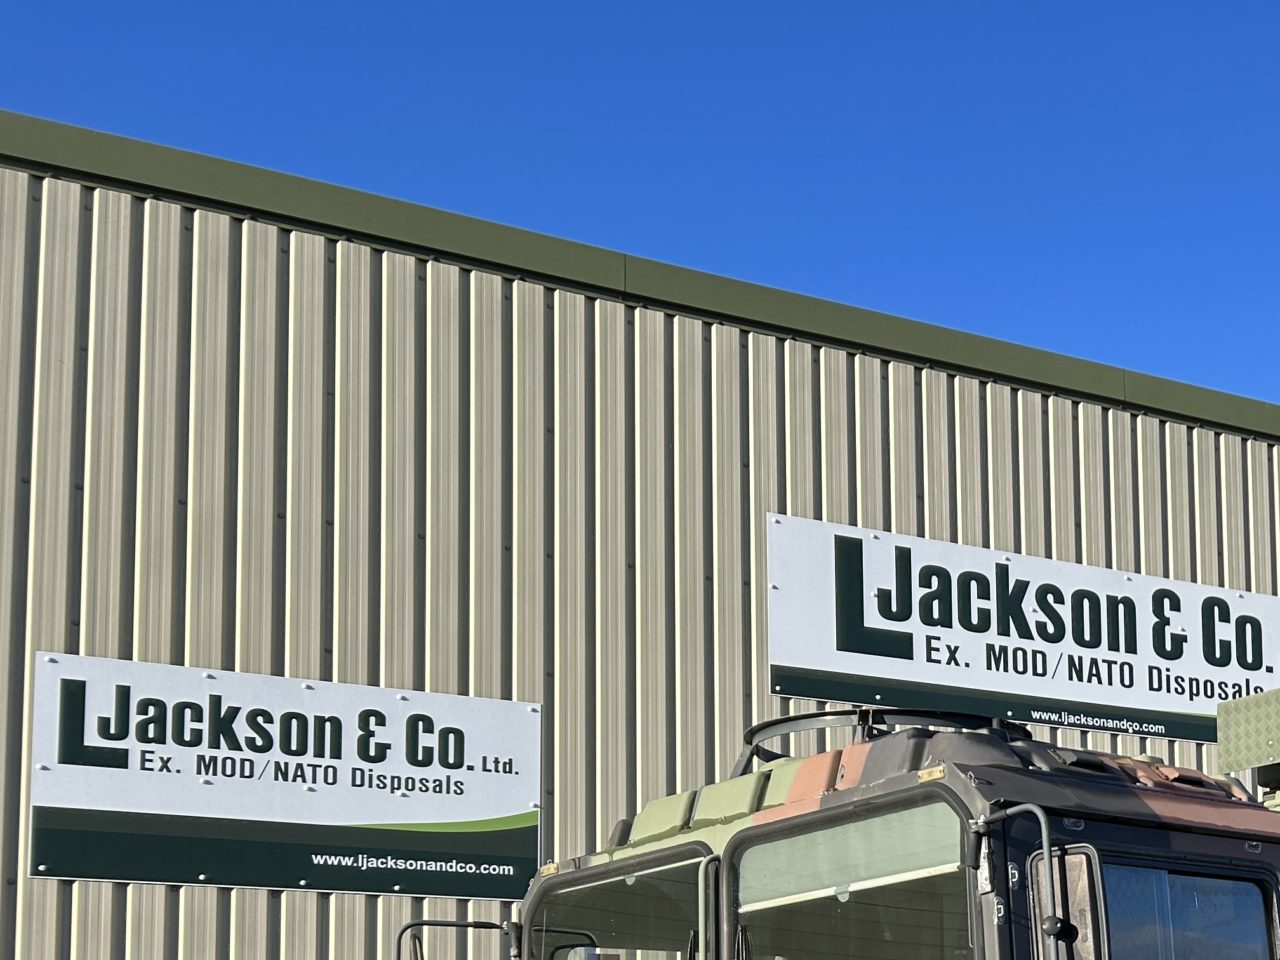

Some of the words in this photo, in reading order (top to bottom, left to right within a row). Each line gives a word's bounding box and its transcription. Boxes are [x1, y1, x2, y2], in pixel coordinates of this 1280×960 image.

[1153, 588, 1187, 661] &
[1201, 596, 1273, 673] Co.
[925, 637, 970, 668] Ex.
[986, 643, 1134, 688] MOD/NATO
[357, 709, 391, 764] &
[405, 713, 475, 771] Co.
[482, 755, 519, 775] Ltd.
[1031, 710, 1165, 733] www.ljacksonandco.com
[140, 750, 181, 773] Ex.
[196, 754, 338, 786] MOD/NATO
[351, 767, 465, 796] Disposals
[312, 854, 514, 875] www.ljacksonandco.com
